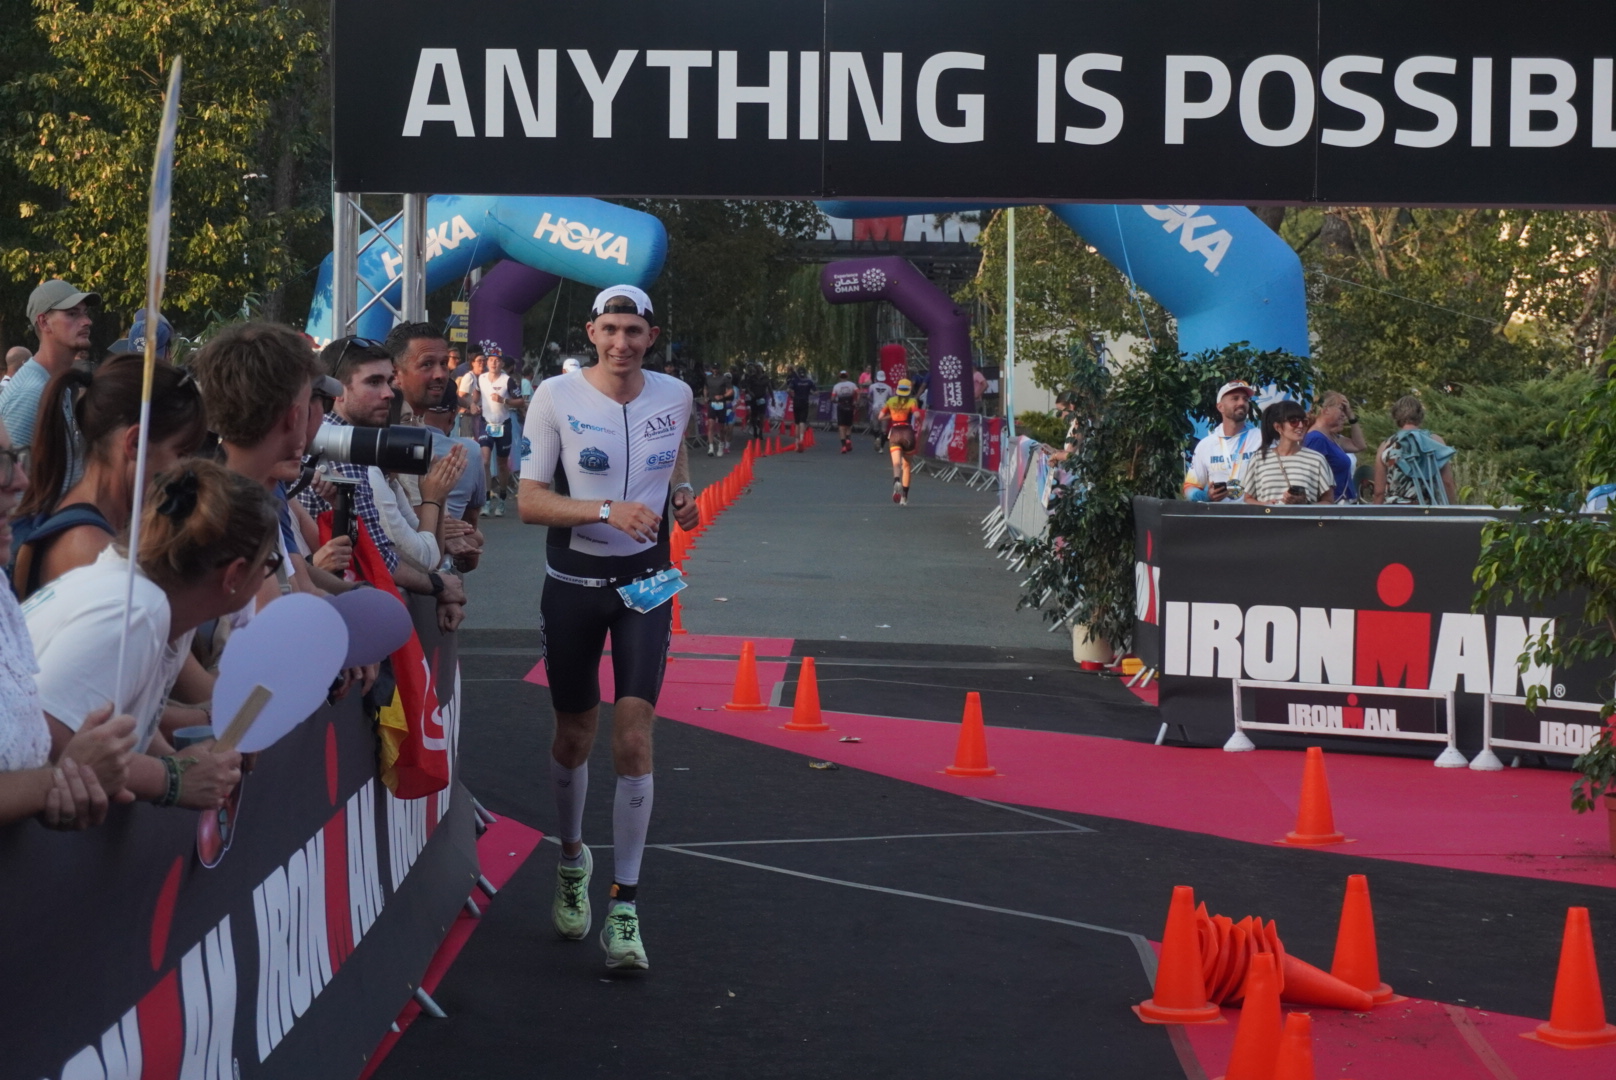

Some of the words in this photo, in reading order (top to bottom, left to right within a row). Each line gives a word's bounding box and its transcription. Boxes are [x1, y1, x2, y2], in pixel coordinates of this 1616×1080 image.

[401, 47, 986, 143] ANYTHING
[1037, 52, 1124, 145] IS
[381, 214, 480, 280] HKA
[532, 212, 629, 266] HOKA
[834, 285, 860, 294] OMAN
[955, 381, 963, 406] OMAN
[580, 423, 616, 436] ensortec
[1164, 601, 1556, 698] IRONMAN
[1288, 702, 1398, 733] IRONMAN
[252, 775, 383, 1064] IRONMAN
